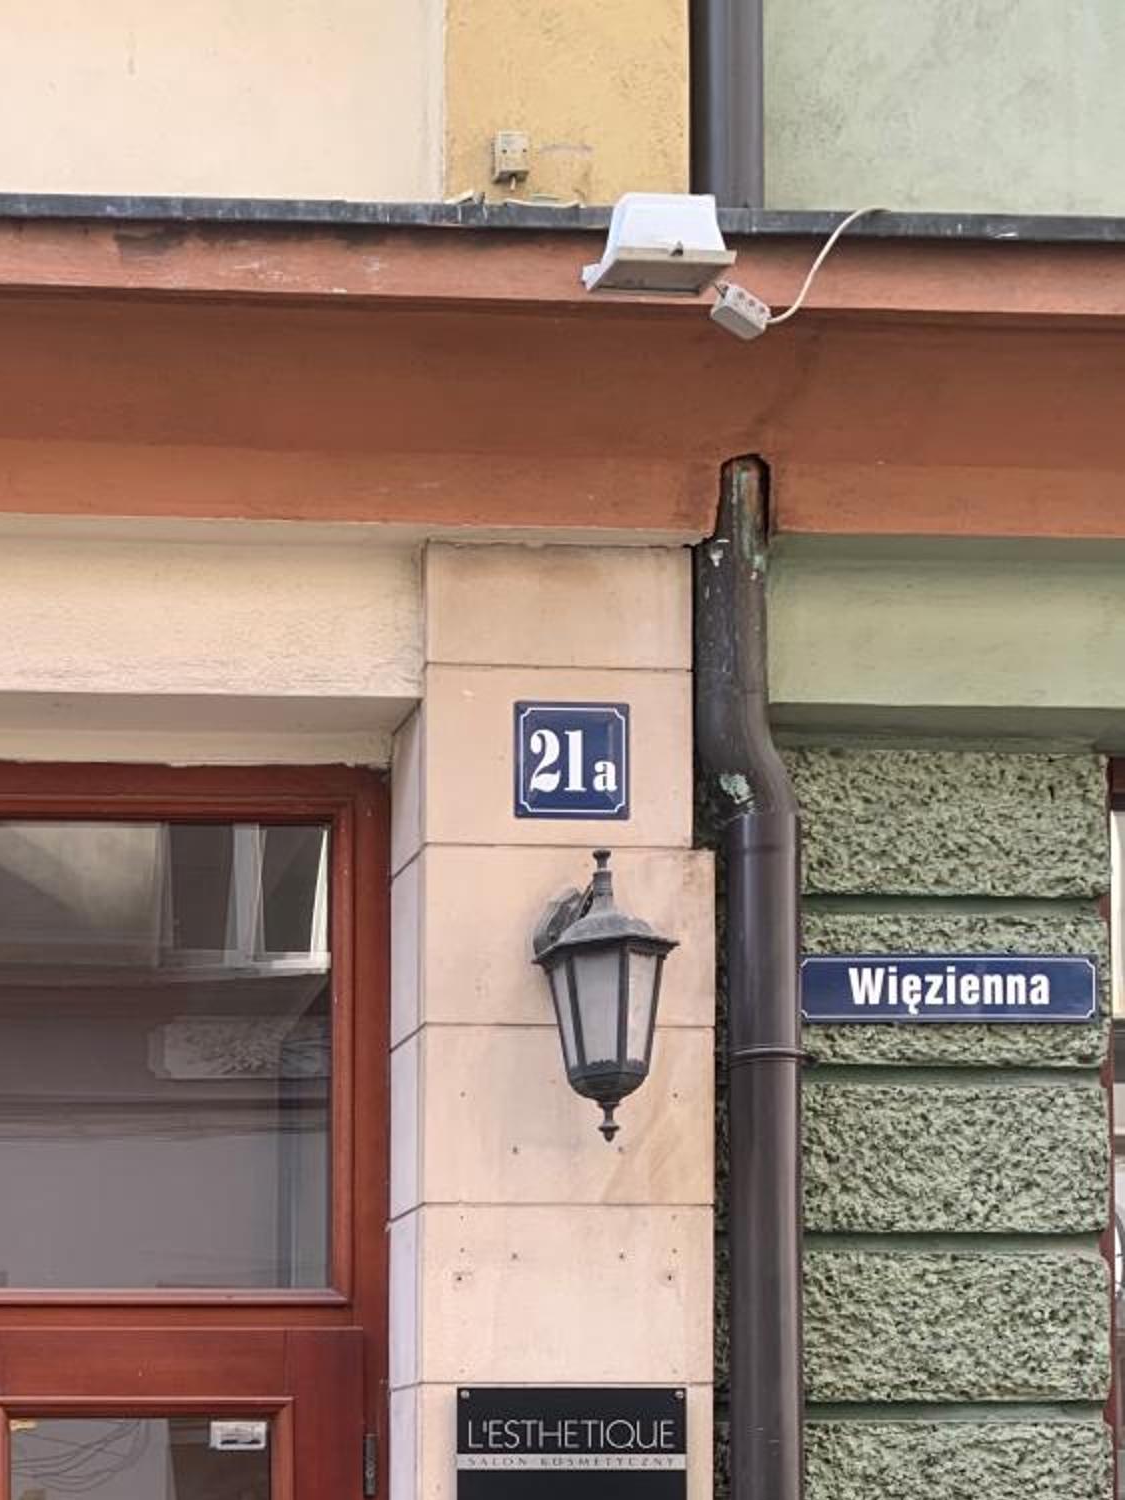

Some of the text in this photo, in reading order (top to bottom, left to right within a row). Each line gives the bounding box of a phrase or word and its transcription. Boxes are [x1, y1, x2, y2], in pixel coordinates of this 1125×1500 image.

[529, 729, 618, 793] 21a
[848, 966, 1050, 1015] Więzienna
[467, 1418, 676, 1450] L'ESTHETIQUE
[467, 1457, 676, 1467] SALON KOSMETYCZNY
